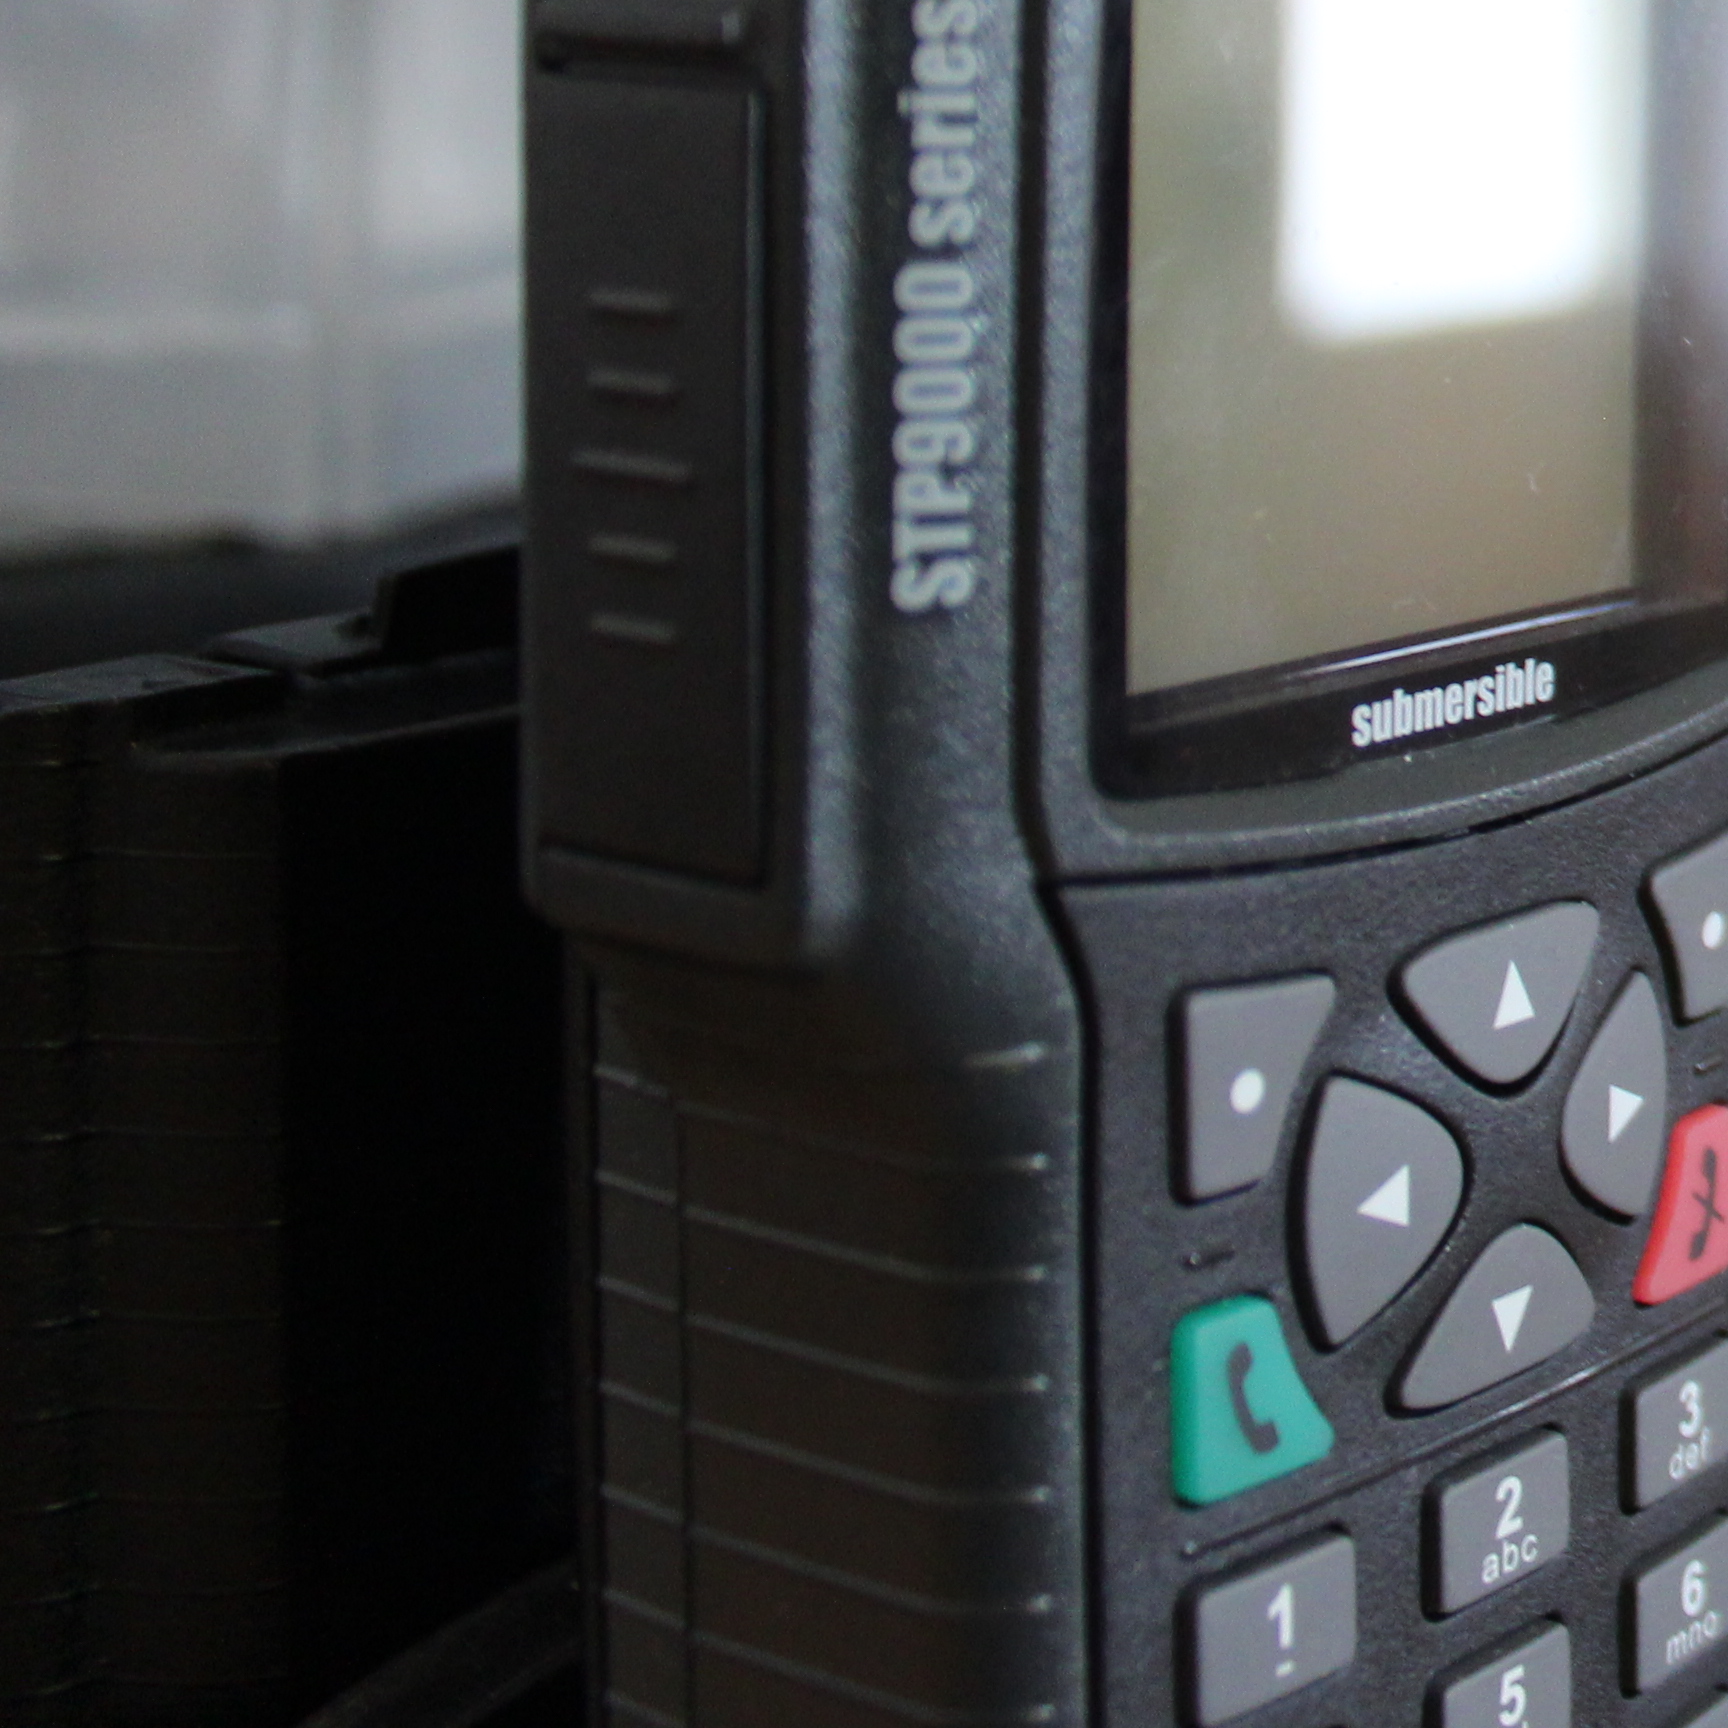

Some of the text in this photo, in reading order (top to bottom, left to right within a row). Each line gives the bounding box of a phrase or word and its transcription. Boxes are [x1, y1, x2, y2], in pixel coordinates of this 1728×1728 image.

[890, 258, 976, 614] STP9000
[1351, 658, 1556, 747] submersible
[1677, 1380, 1702, 1439] 3
[1668, 1426, 1712, 1481] def
[1494, 1475, 1524, 1540] 2
[1480, 1533, 1540, 1584] abc
[1680, 1559, 1708, 1618] 6
[1266, 1582, 1294, 1650] 1
[1664, 1608, 1723, 1666] mno
[1498, 1664, 1527, 1727] 5
